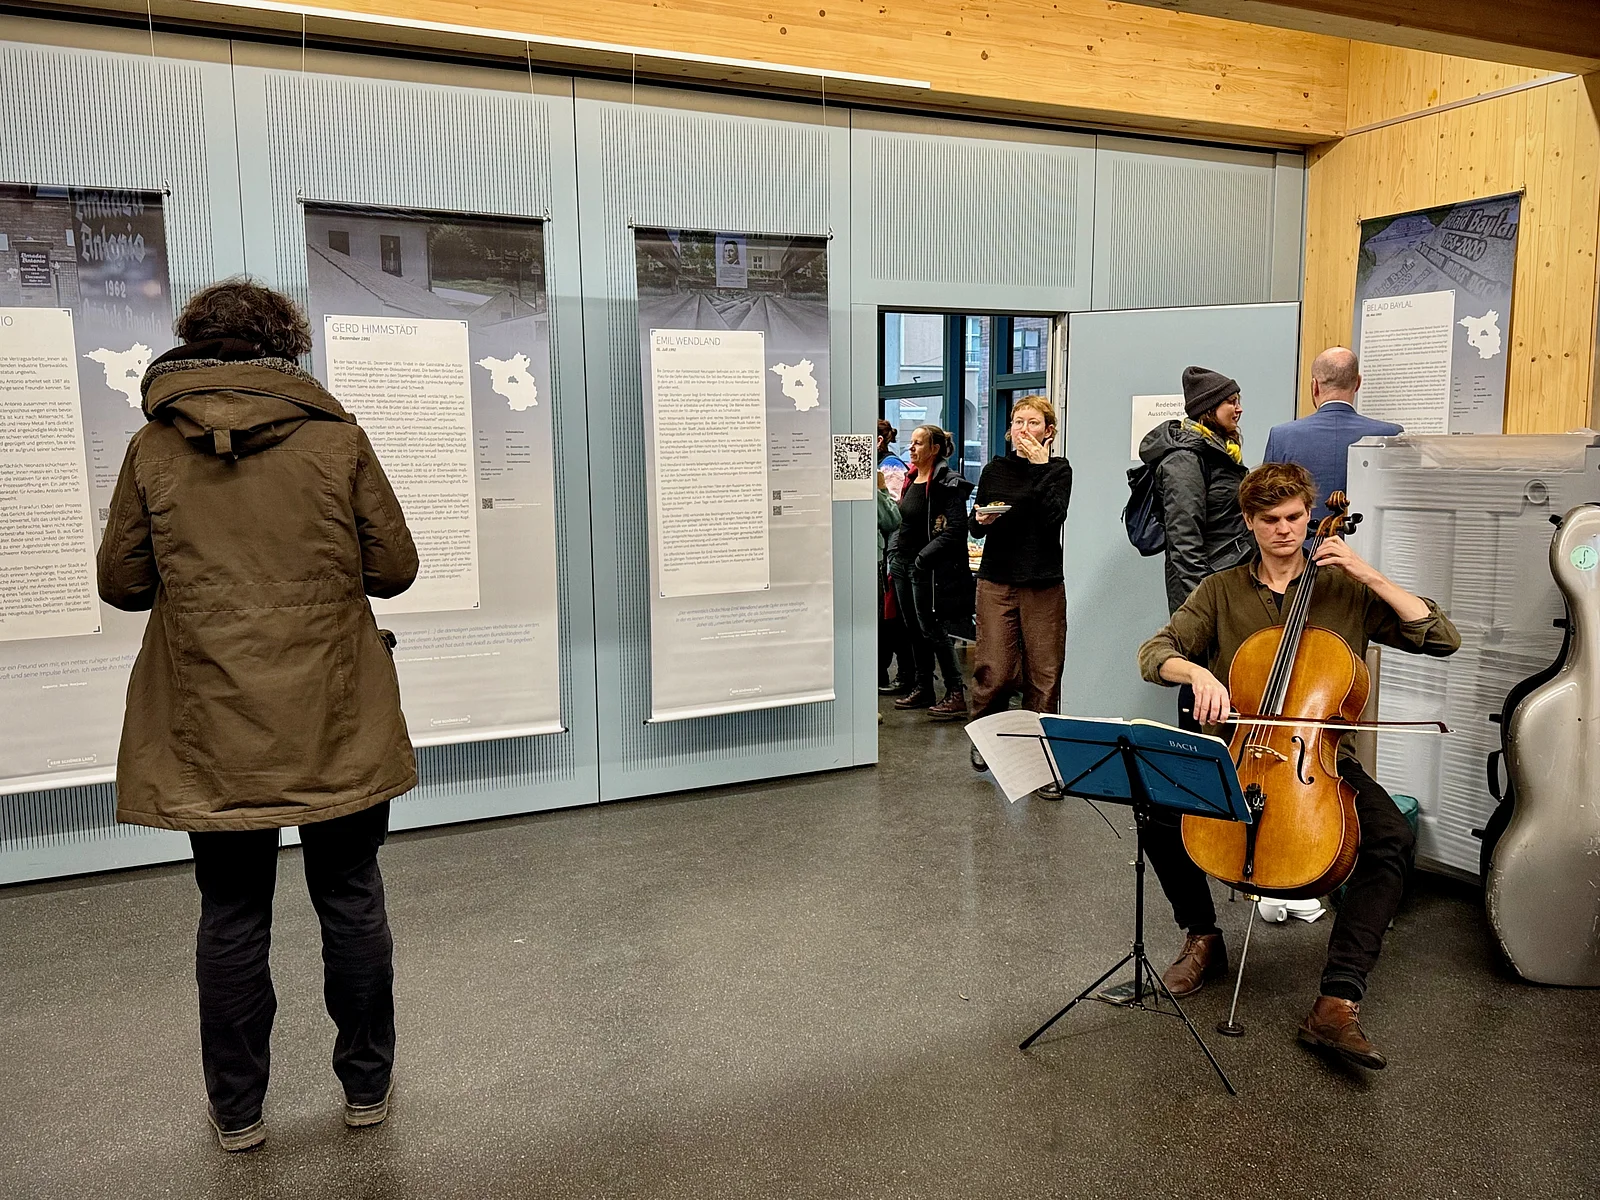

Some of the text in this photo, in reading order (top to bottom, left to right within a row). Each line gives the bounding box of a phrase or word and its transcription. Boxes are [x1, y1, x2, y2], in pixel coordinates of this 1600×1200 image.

[80, 222, 146, 263] Antonio
[105, 280, 127, 298] 1962
[1366, 301, 1413, 311] BELAID BAYLAL
[332, 322, 418, 335] GERD HIMMSTÄDT
[656, 336, 721, 346] EMIL WENDLAND
[17, 662, 37, 670] Freund
[70, 658, 87, 667] netter,
[89, 656, 109, 666] ruhiger
[40, 669, 61, 679] Impulse
[62, 667, 79, 675] fehlen.
[1169, 740, 1198, 752] BACH
